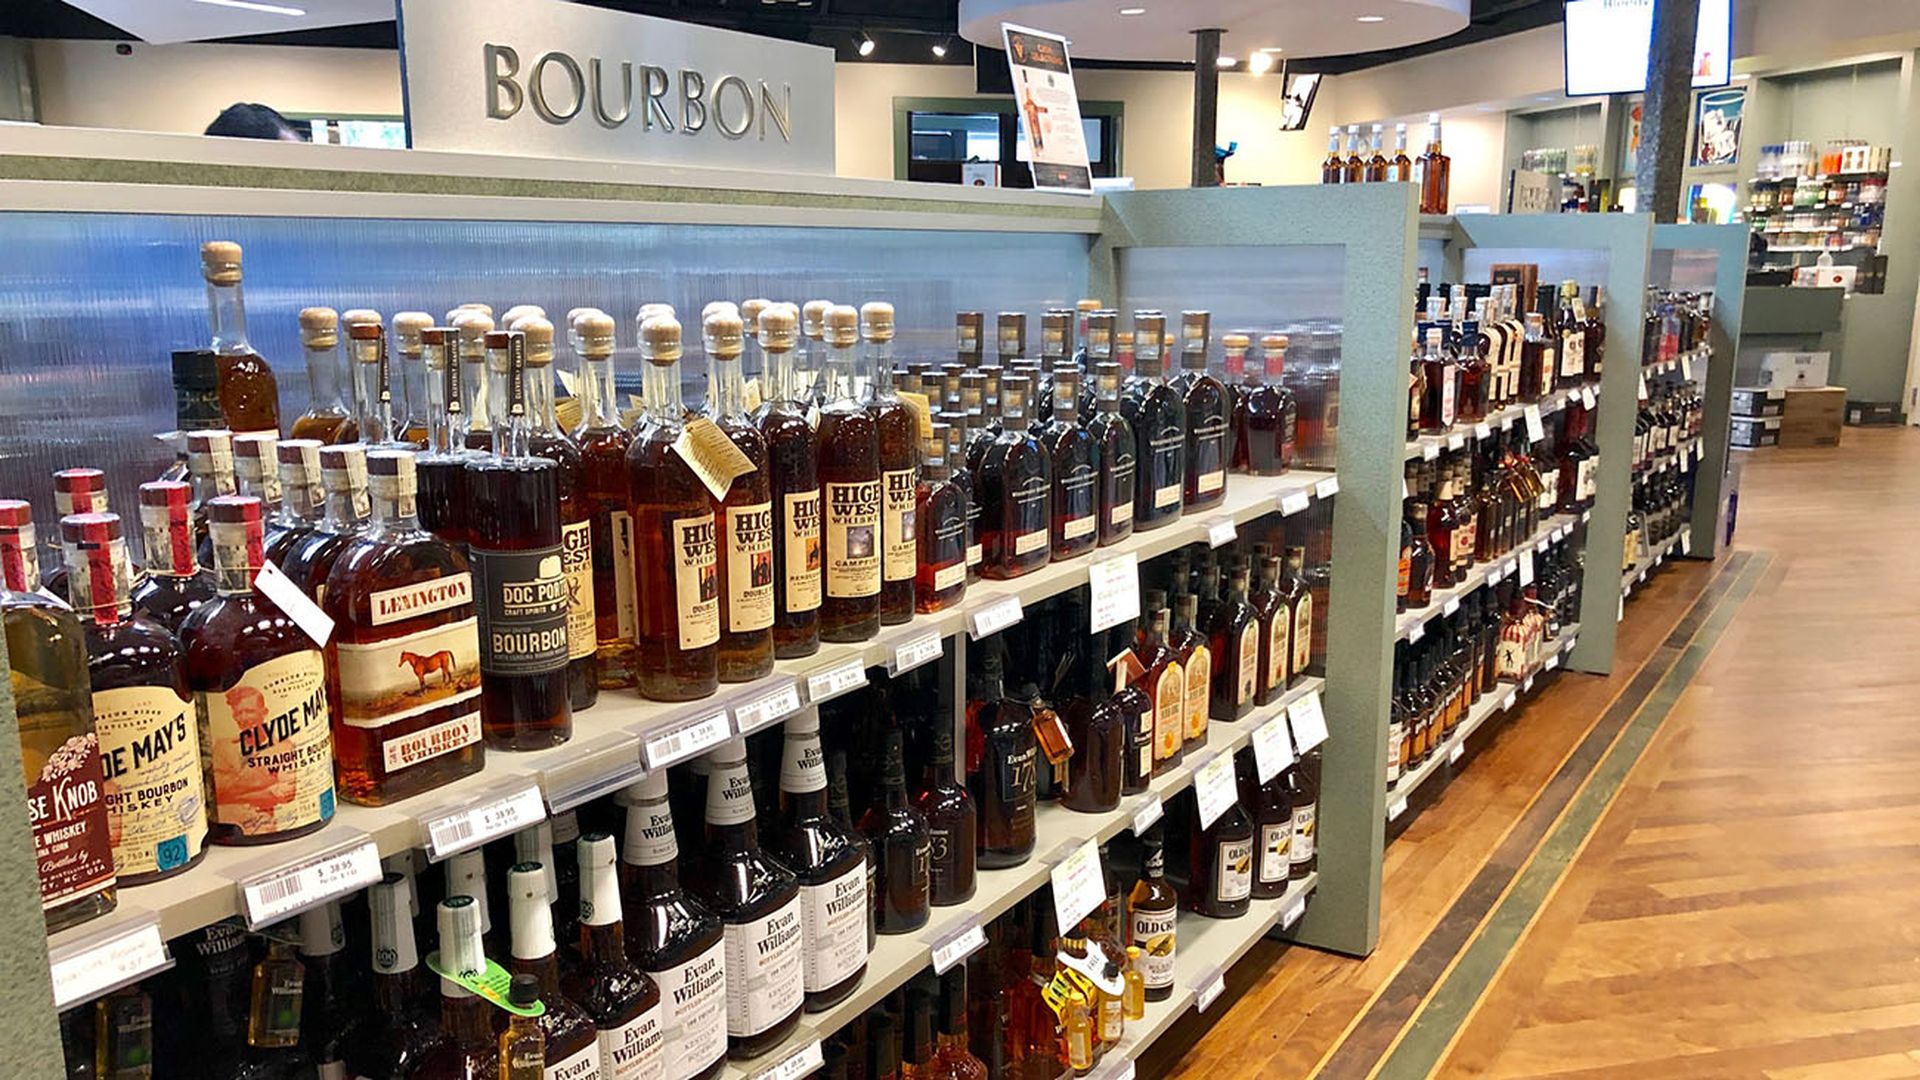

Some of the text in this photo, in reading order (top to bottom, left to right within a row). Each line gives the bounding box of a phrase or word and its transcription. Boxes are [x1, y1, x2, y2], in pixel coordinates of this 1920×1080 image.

[483, 42, 791, 143] BOURBON
[793, 497, 820, 519] HIG
[683, 519, 716, 545] HIG
[735, 511, 772, 532] HIG
[563, 527, 590, 551] GH
[736, 528, 772, 544] WES
[683, 541, 717, 558] WES
[379, 581, 466, 616] LEXINGTON
[503, 580, 567, 604] DOC PORT
[492, 625, 567, 654] BOURBON
[239, 705, 301, 757] CLYDE
[400, 724, 469, 756] BOURBON
[100, 746, 128, 782] DE
[131, 710, 187, 769] MAY'S
[247, 736, 331, 768] STRAIGHT BOURB
[401, 735, 469, 764] WHISKEY
[267, 751, 328, 774] WHISKEY
[28, 776, 98, 822] SE KNOB
[105, 777, 189, 807] GHT BOURBON
[105, 795, 174, 814] HISKEY
[43, 821, 87, 846] WHISKEY
[41, 849, 88, 873] Bottled by
[162, 845, 181, 864] 92
[86, 864, 106, 876] USA
[835, 876, 861, 898] Evan
[826, 886, 866, 916] Williams
[767, 911, 795, 937] Evan
[1136, 920, 1159, 935] OLD
[196, 935, 242, 956] Willia
[757, 920, 801, 956] Williams
[683, 957, 716, 985] Evan
[673, 966, 724, 1006] Williams
[623, 1018, 657, 1045] Evan
[554, 1057, 591, 1080] Evan
